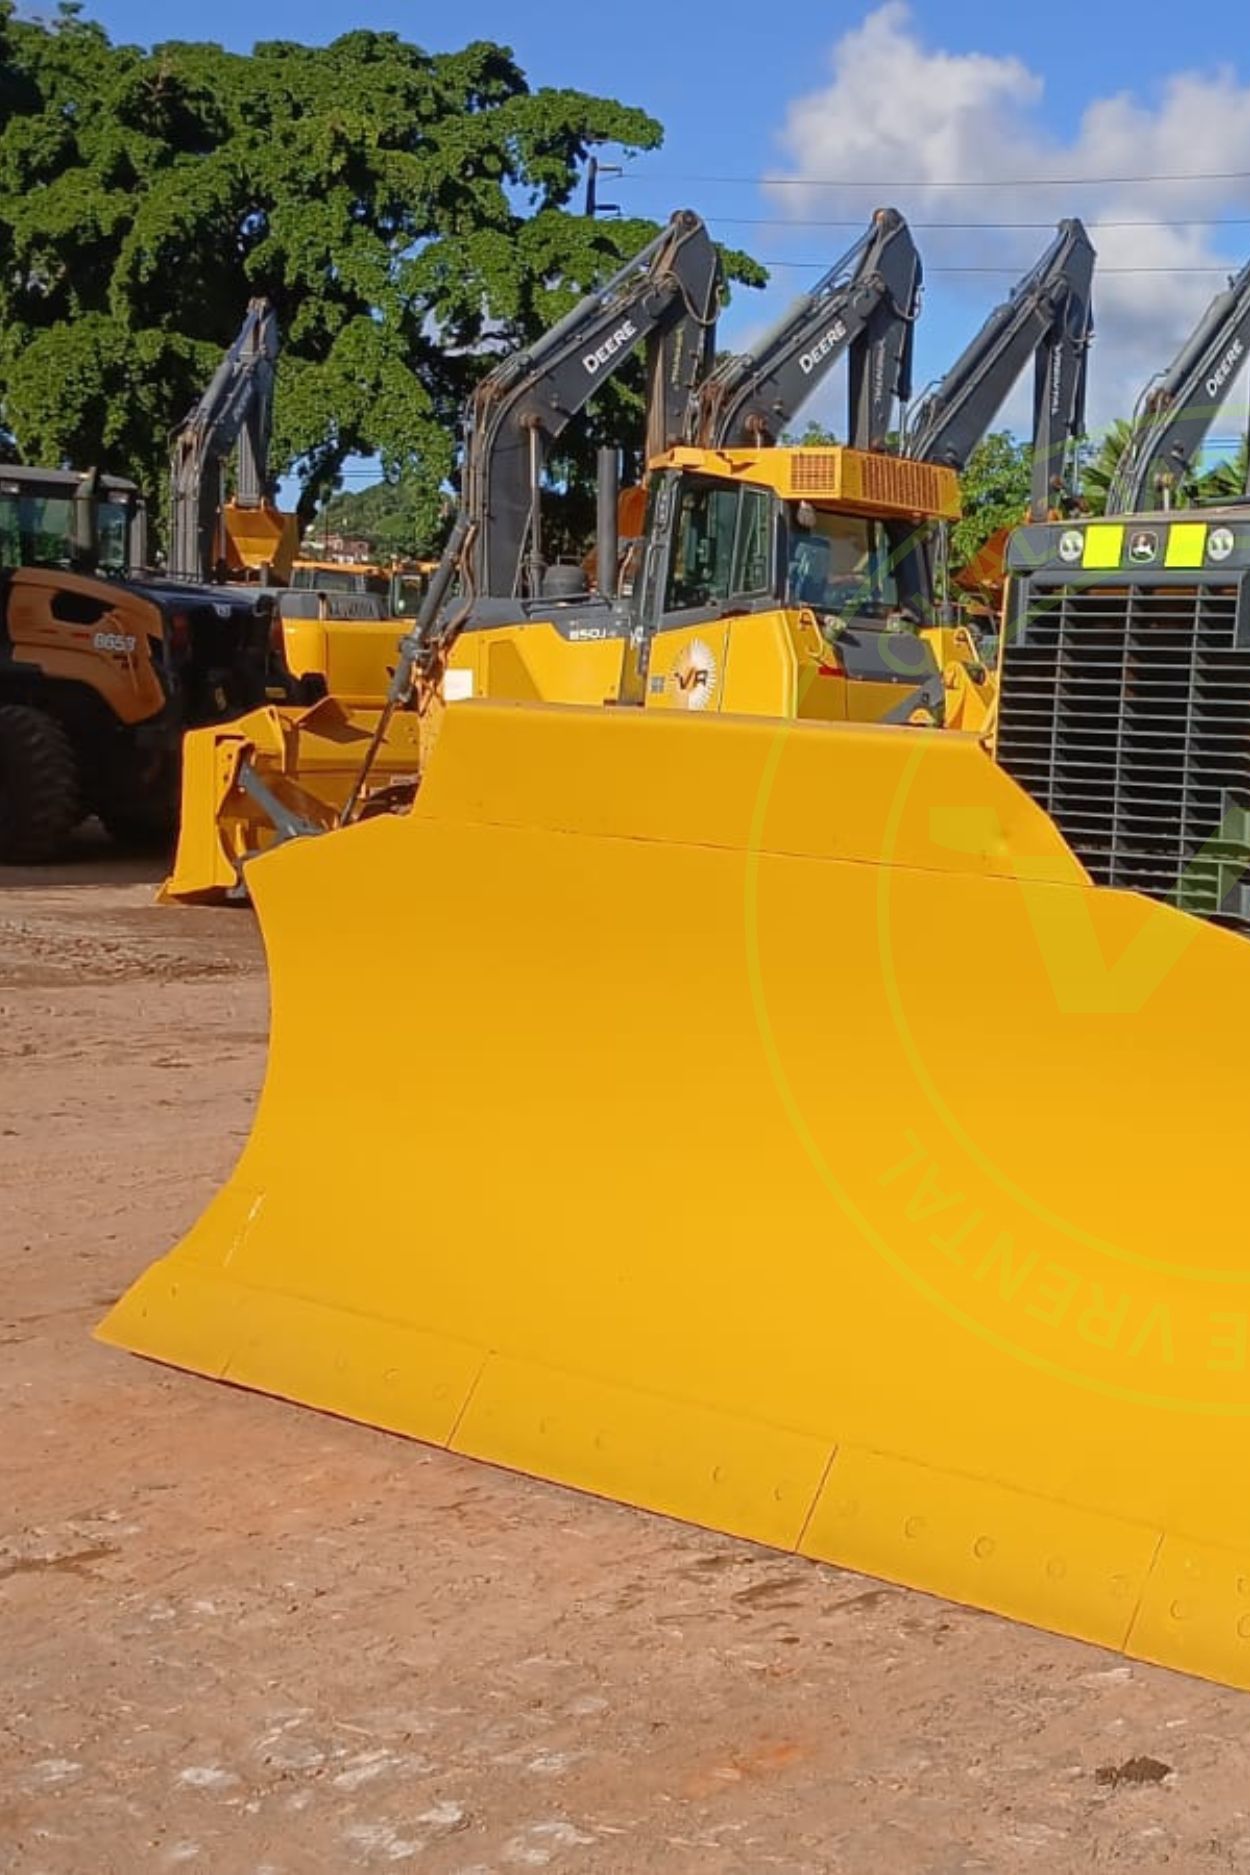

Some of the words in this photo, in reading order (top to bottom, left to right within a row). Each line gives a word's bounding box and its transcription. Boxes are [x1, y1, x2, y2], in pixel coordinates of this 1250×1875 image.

[582, 320, 638, 375] DEERE
[799, 320, 847, 375] DEERE
[1205, 338, 1244, 398] DEERE
[674, 667, 709, 690] VR
